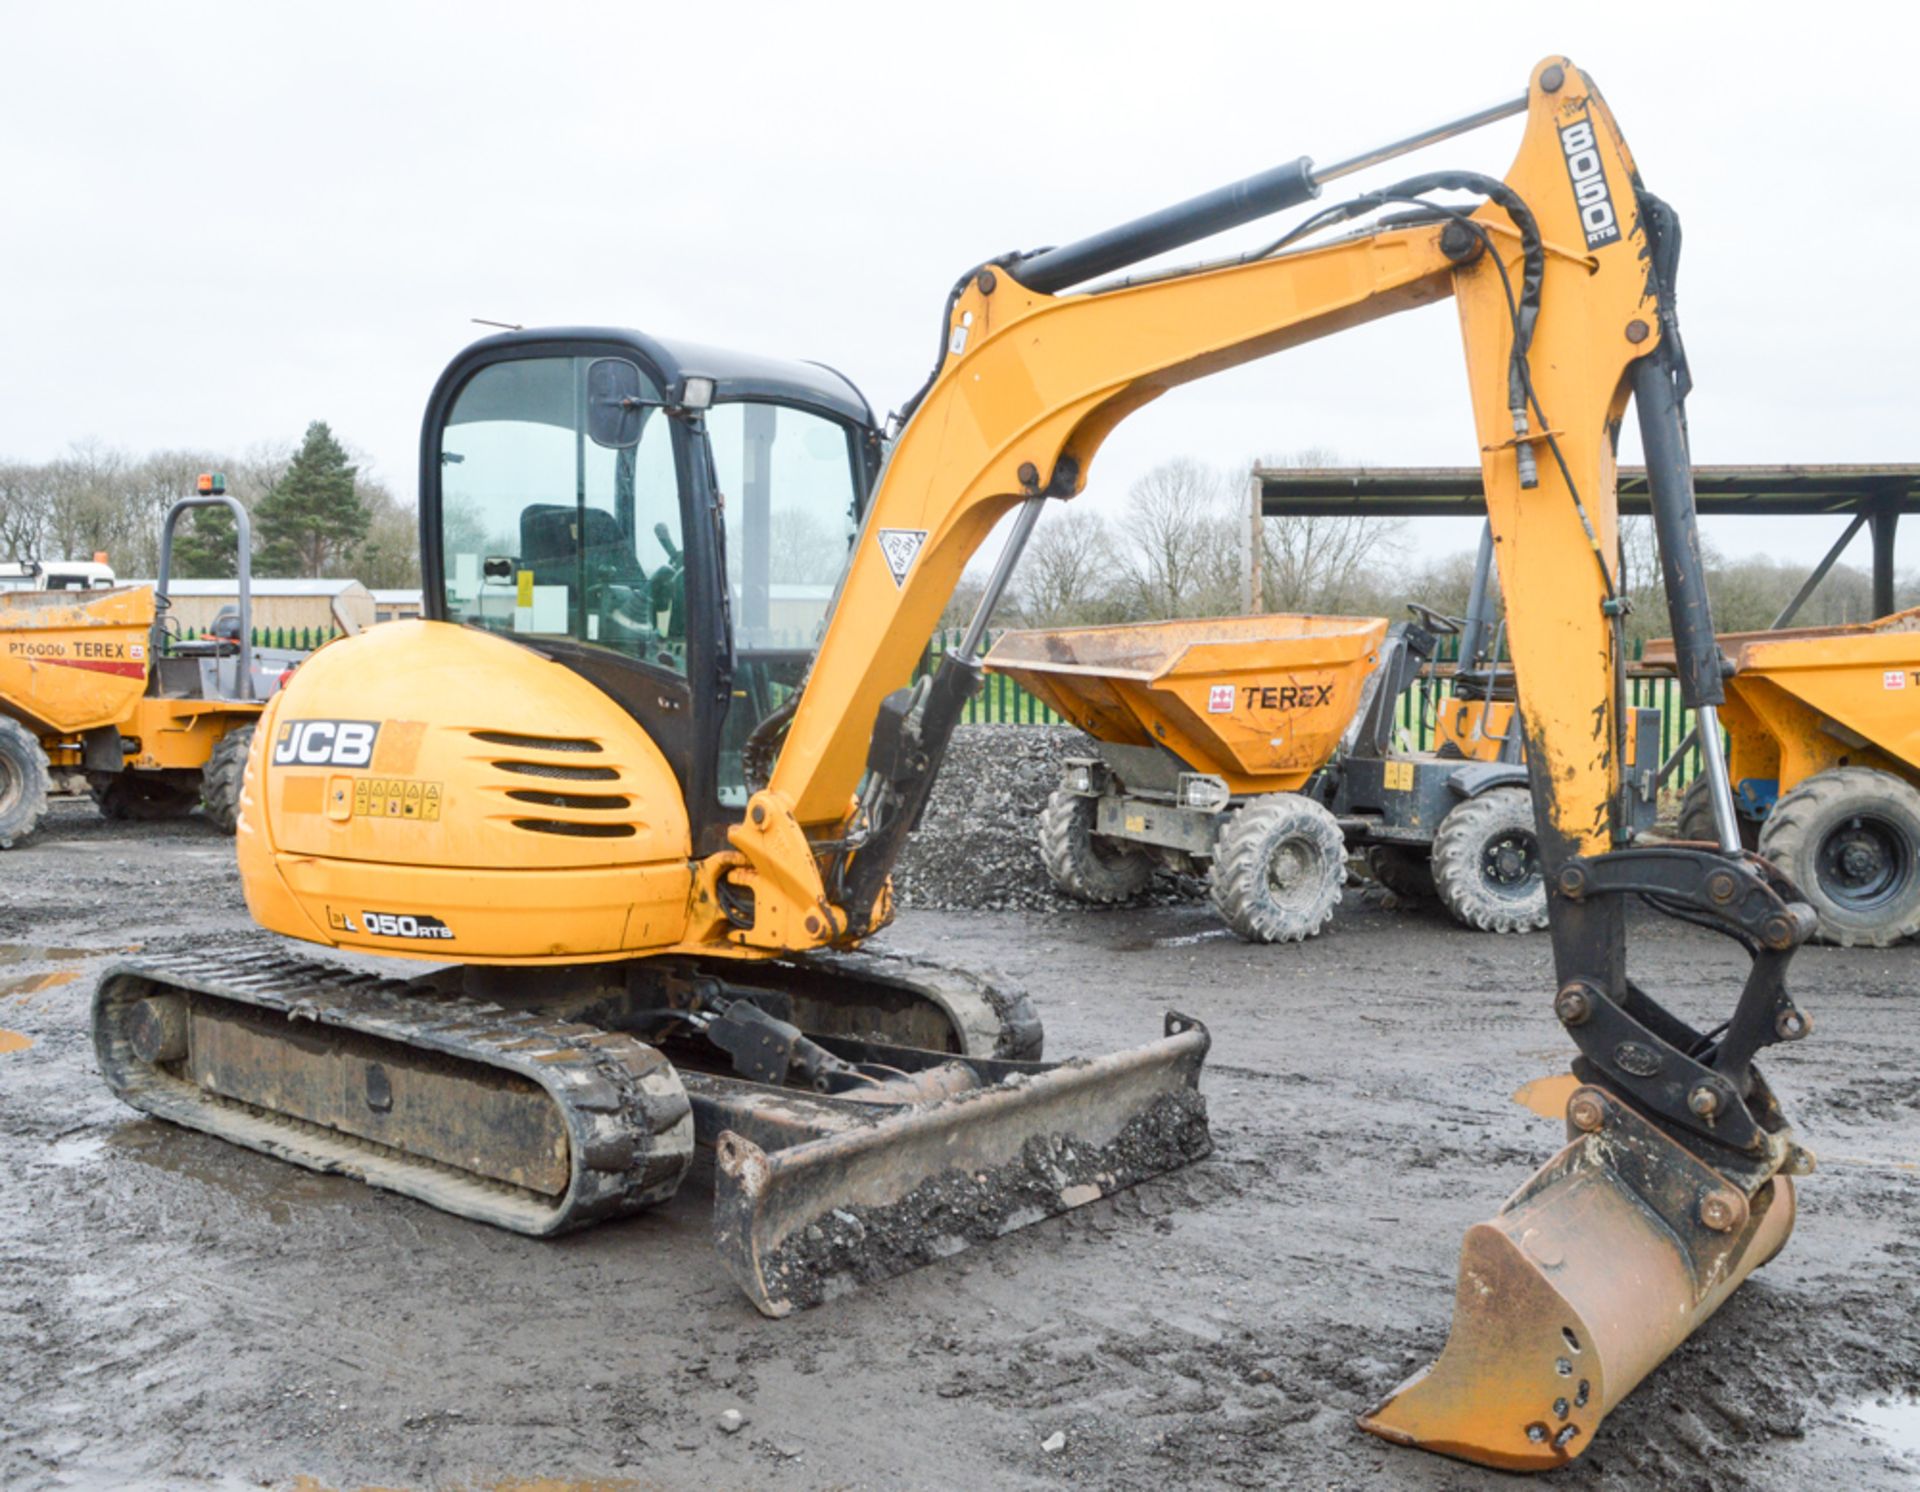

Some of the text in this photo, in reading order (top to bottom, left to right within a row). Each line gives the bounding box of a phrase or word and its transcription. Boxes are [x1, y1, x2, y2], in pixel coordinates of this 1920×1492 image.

[1561, 121, 1614, 232] 8050
[9, 641, 125, 658] PT6000 TEREX
[1242, 685, 1333, 709] TEREX
[275, 722, 375, 764] JCB
[344, 914, 417, 935] 050
